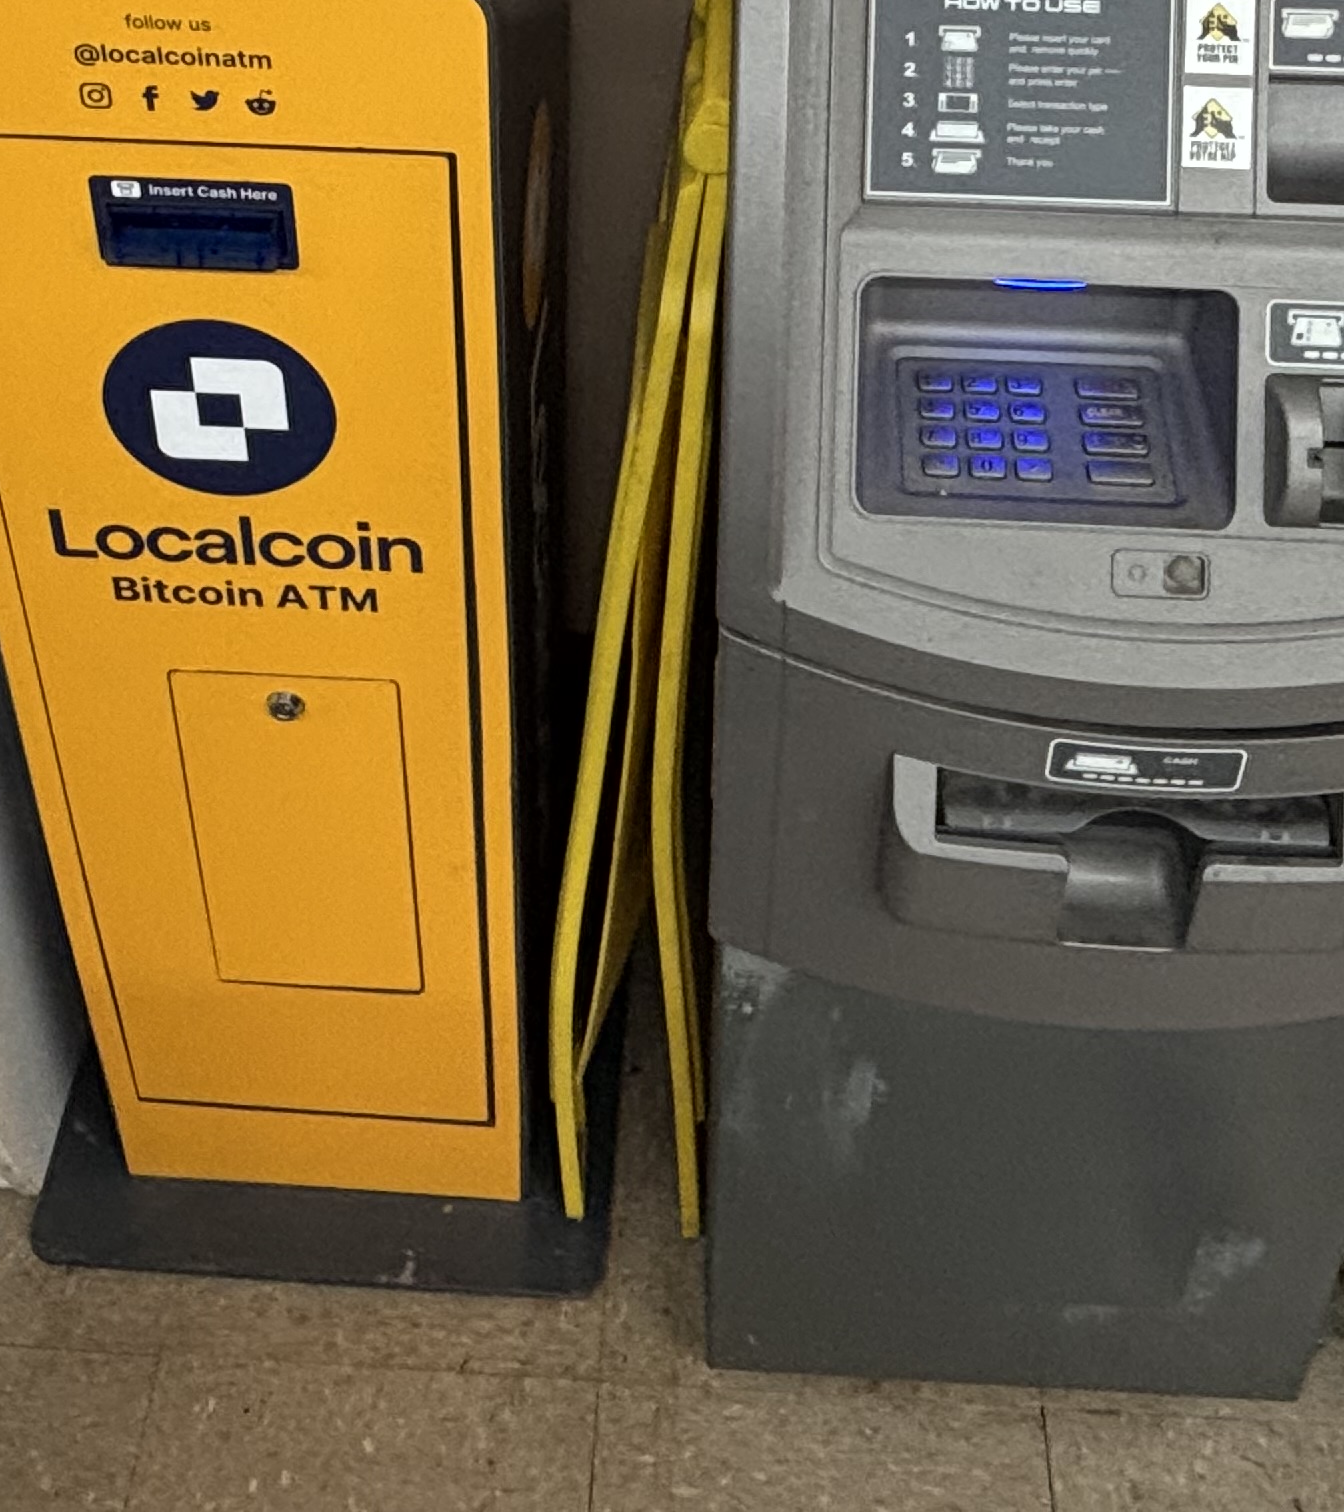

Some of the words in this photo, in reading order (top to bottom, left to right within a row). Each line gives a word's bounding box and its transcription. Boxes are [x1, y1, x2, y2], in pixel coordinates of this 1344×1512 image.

[124, 14, 182, 31] follow
[189, 17, 211, 31] us
[74, 44, 272, 69] @localcoinatm
[149, 185, 194, 197] Insert
[197, 186, 237, 199] Cash
[241, 189, 277, 201] Here
[48, 508, 423, 573] Localcoin
[112, 576, 263, 607] Bitcoin
[277, 585, 378, 612] ATM
